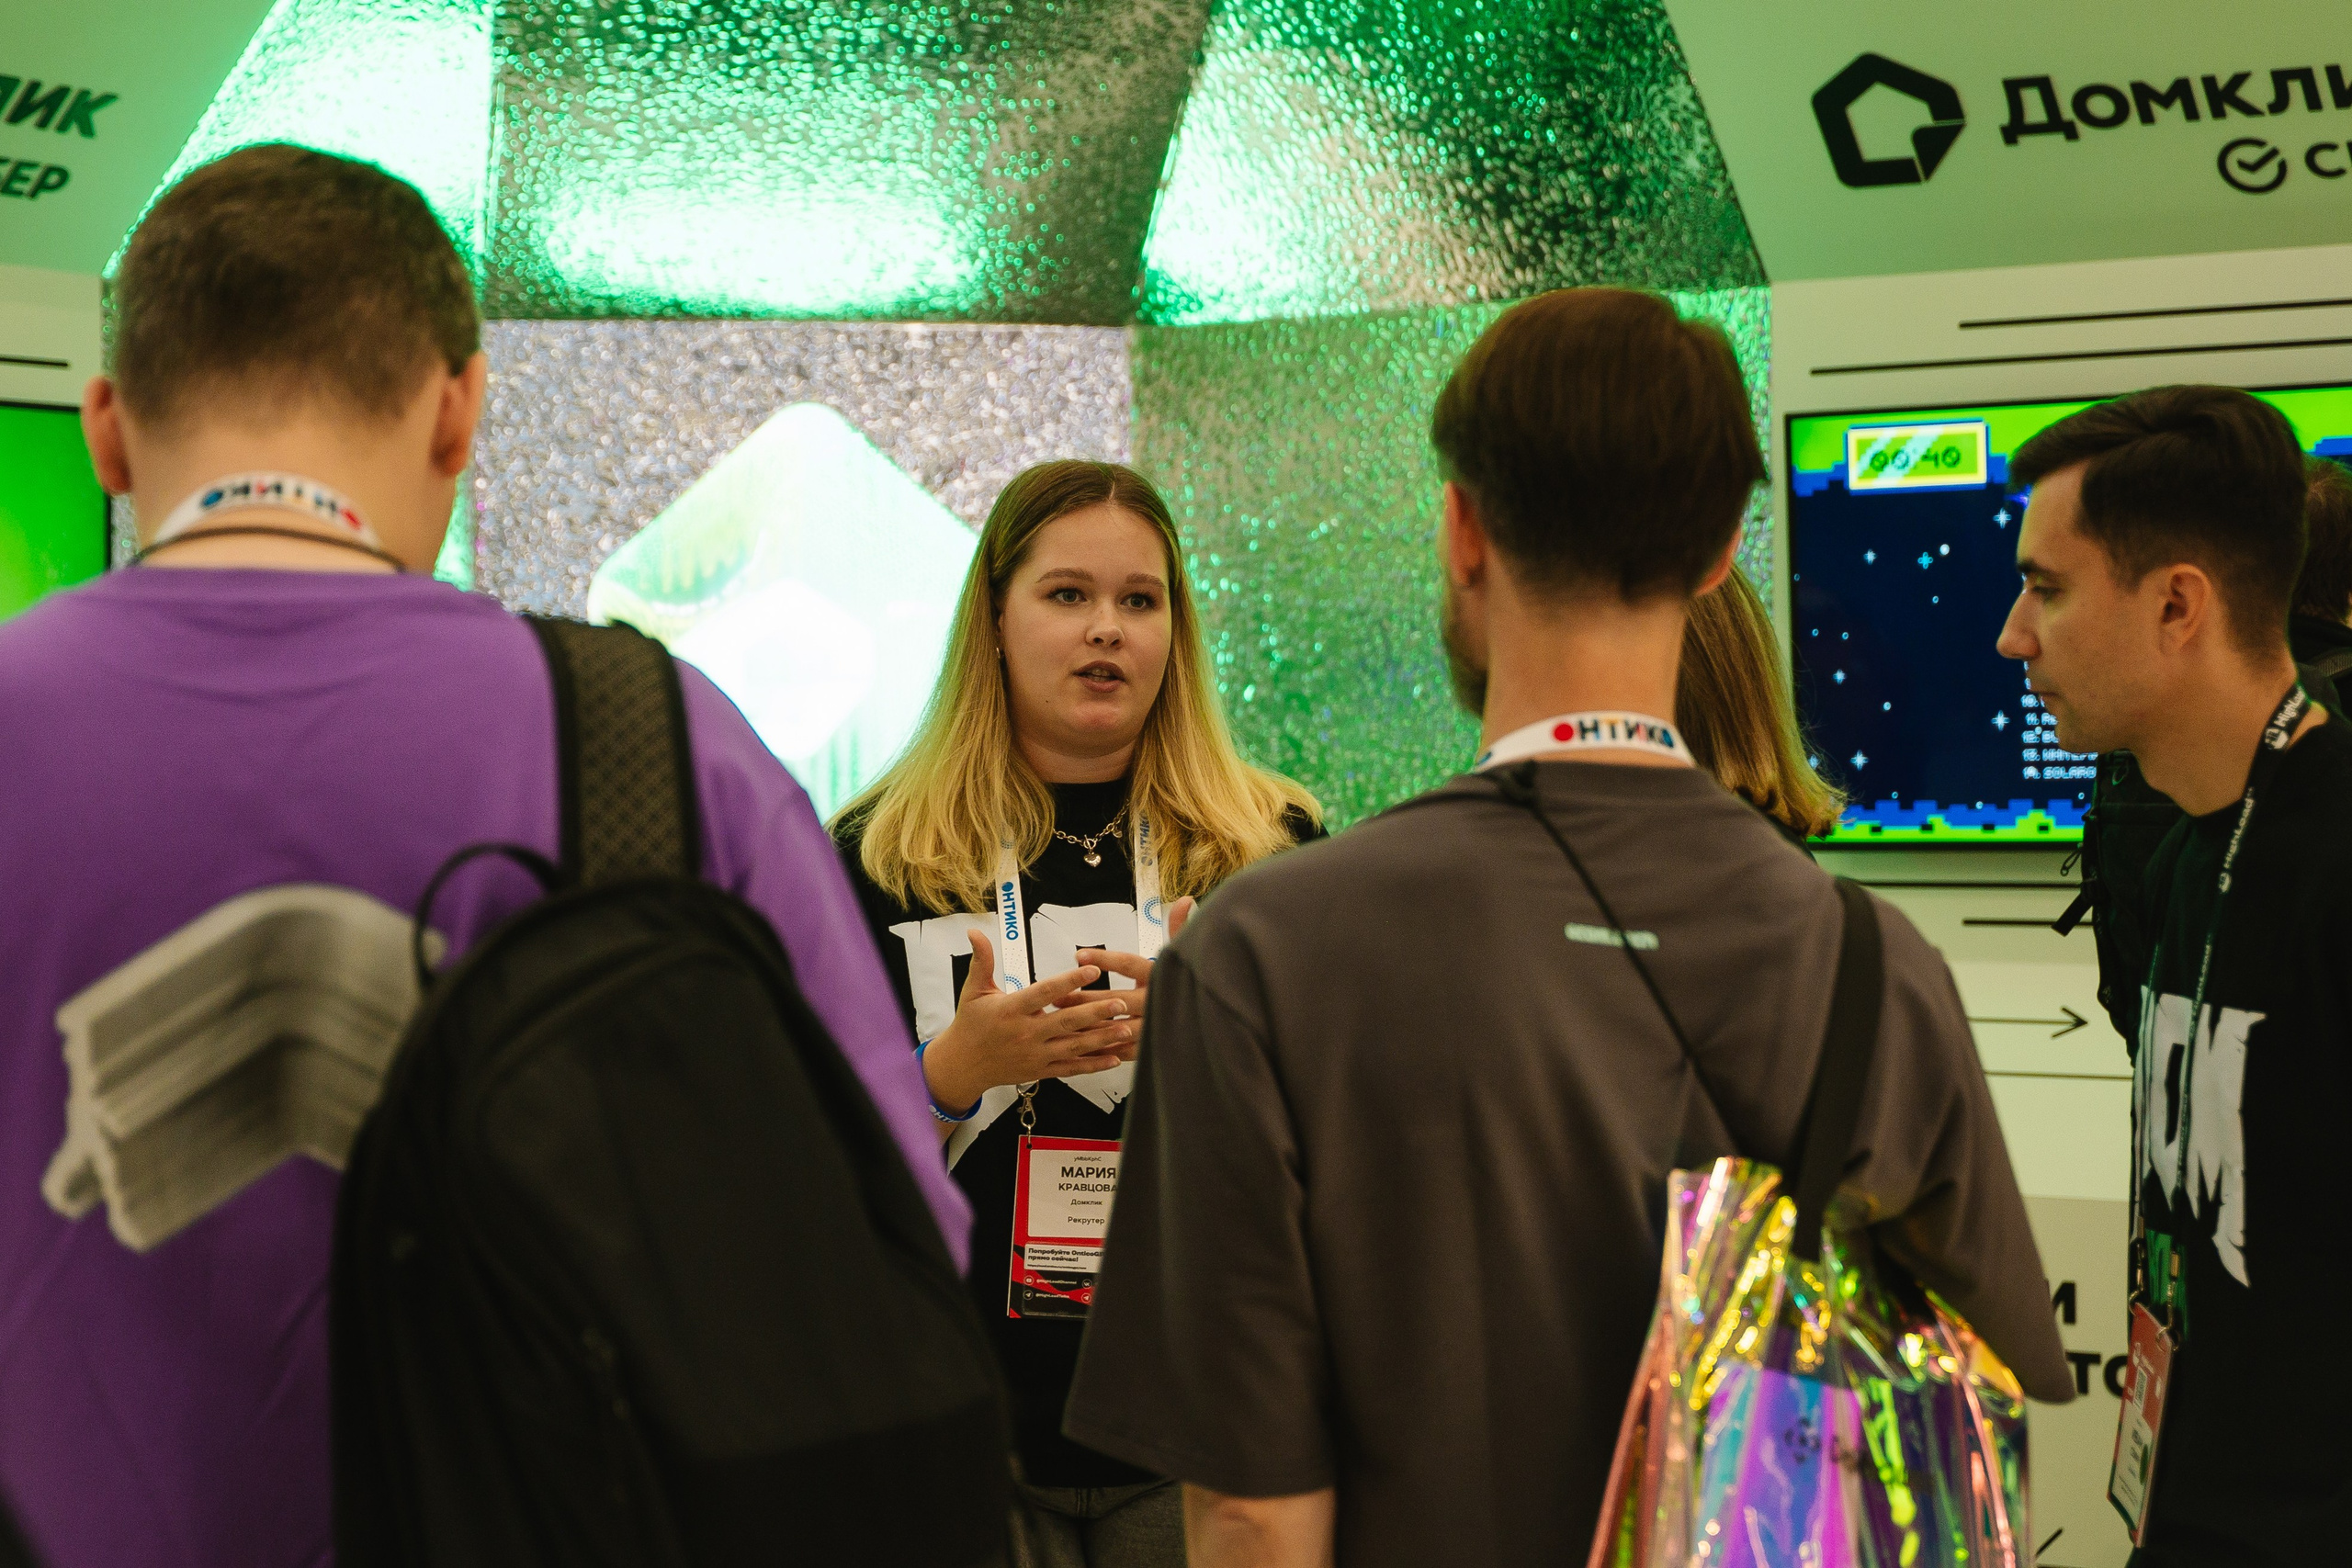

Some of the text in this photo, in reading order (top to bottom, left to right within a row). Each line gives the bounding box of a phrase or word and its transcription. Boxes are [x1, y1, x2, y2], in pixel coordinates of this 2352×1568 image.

[1001, 881, 1019, 941] ОНТИКО
[1060, 1166, 1116, 1179] МАРИЯ
[1057, 1182, 1118, 1193] КРАВЦОВА
[1070, 1198, 1102, 1206] Домклик
[1067, 1216, 1105, 1225] Рекрутер
[1028, 1247, 1070, 1257] Попробуйте
